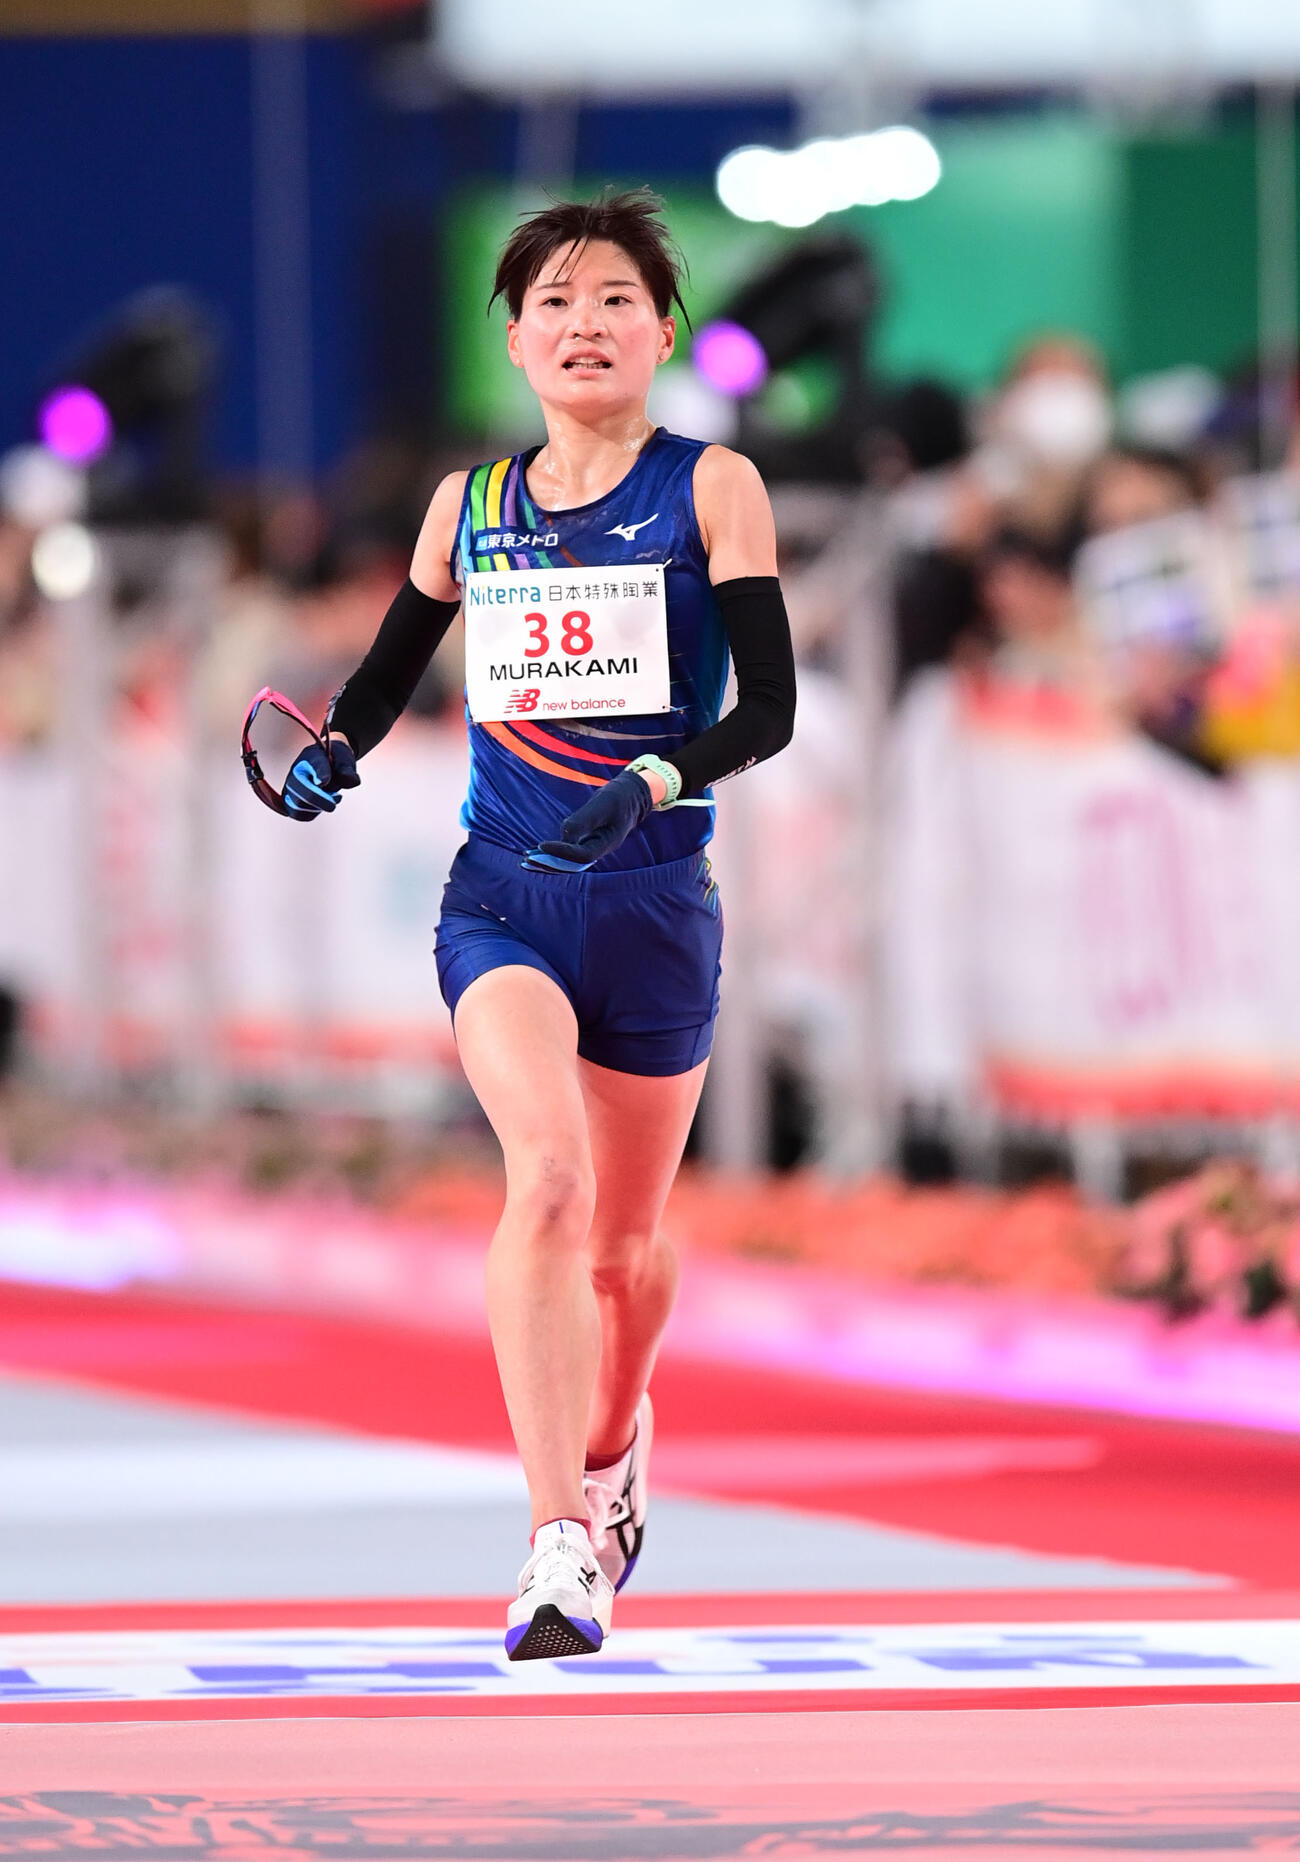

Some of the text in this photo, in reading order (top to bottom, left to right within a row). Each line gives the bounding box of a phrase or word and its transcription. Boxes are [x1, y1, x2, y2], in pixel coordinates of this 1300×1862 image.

[487, 532, 559, 548] 東京メトロ
[470, 581, 658, 606] Niterra 日本特殊陶業
[524, 610, 594, 658] 38
[489, 657, 638, 681] MURAKAMI
[543, 701, 567, 711] new
[571, 697, 626, 710] balance
